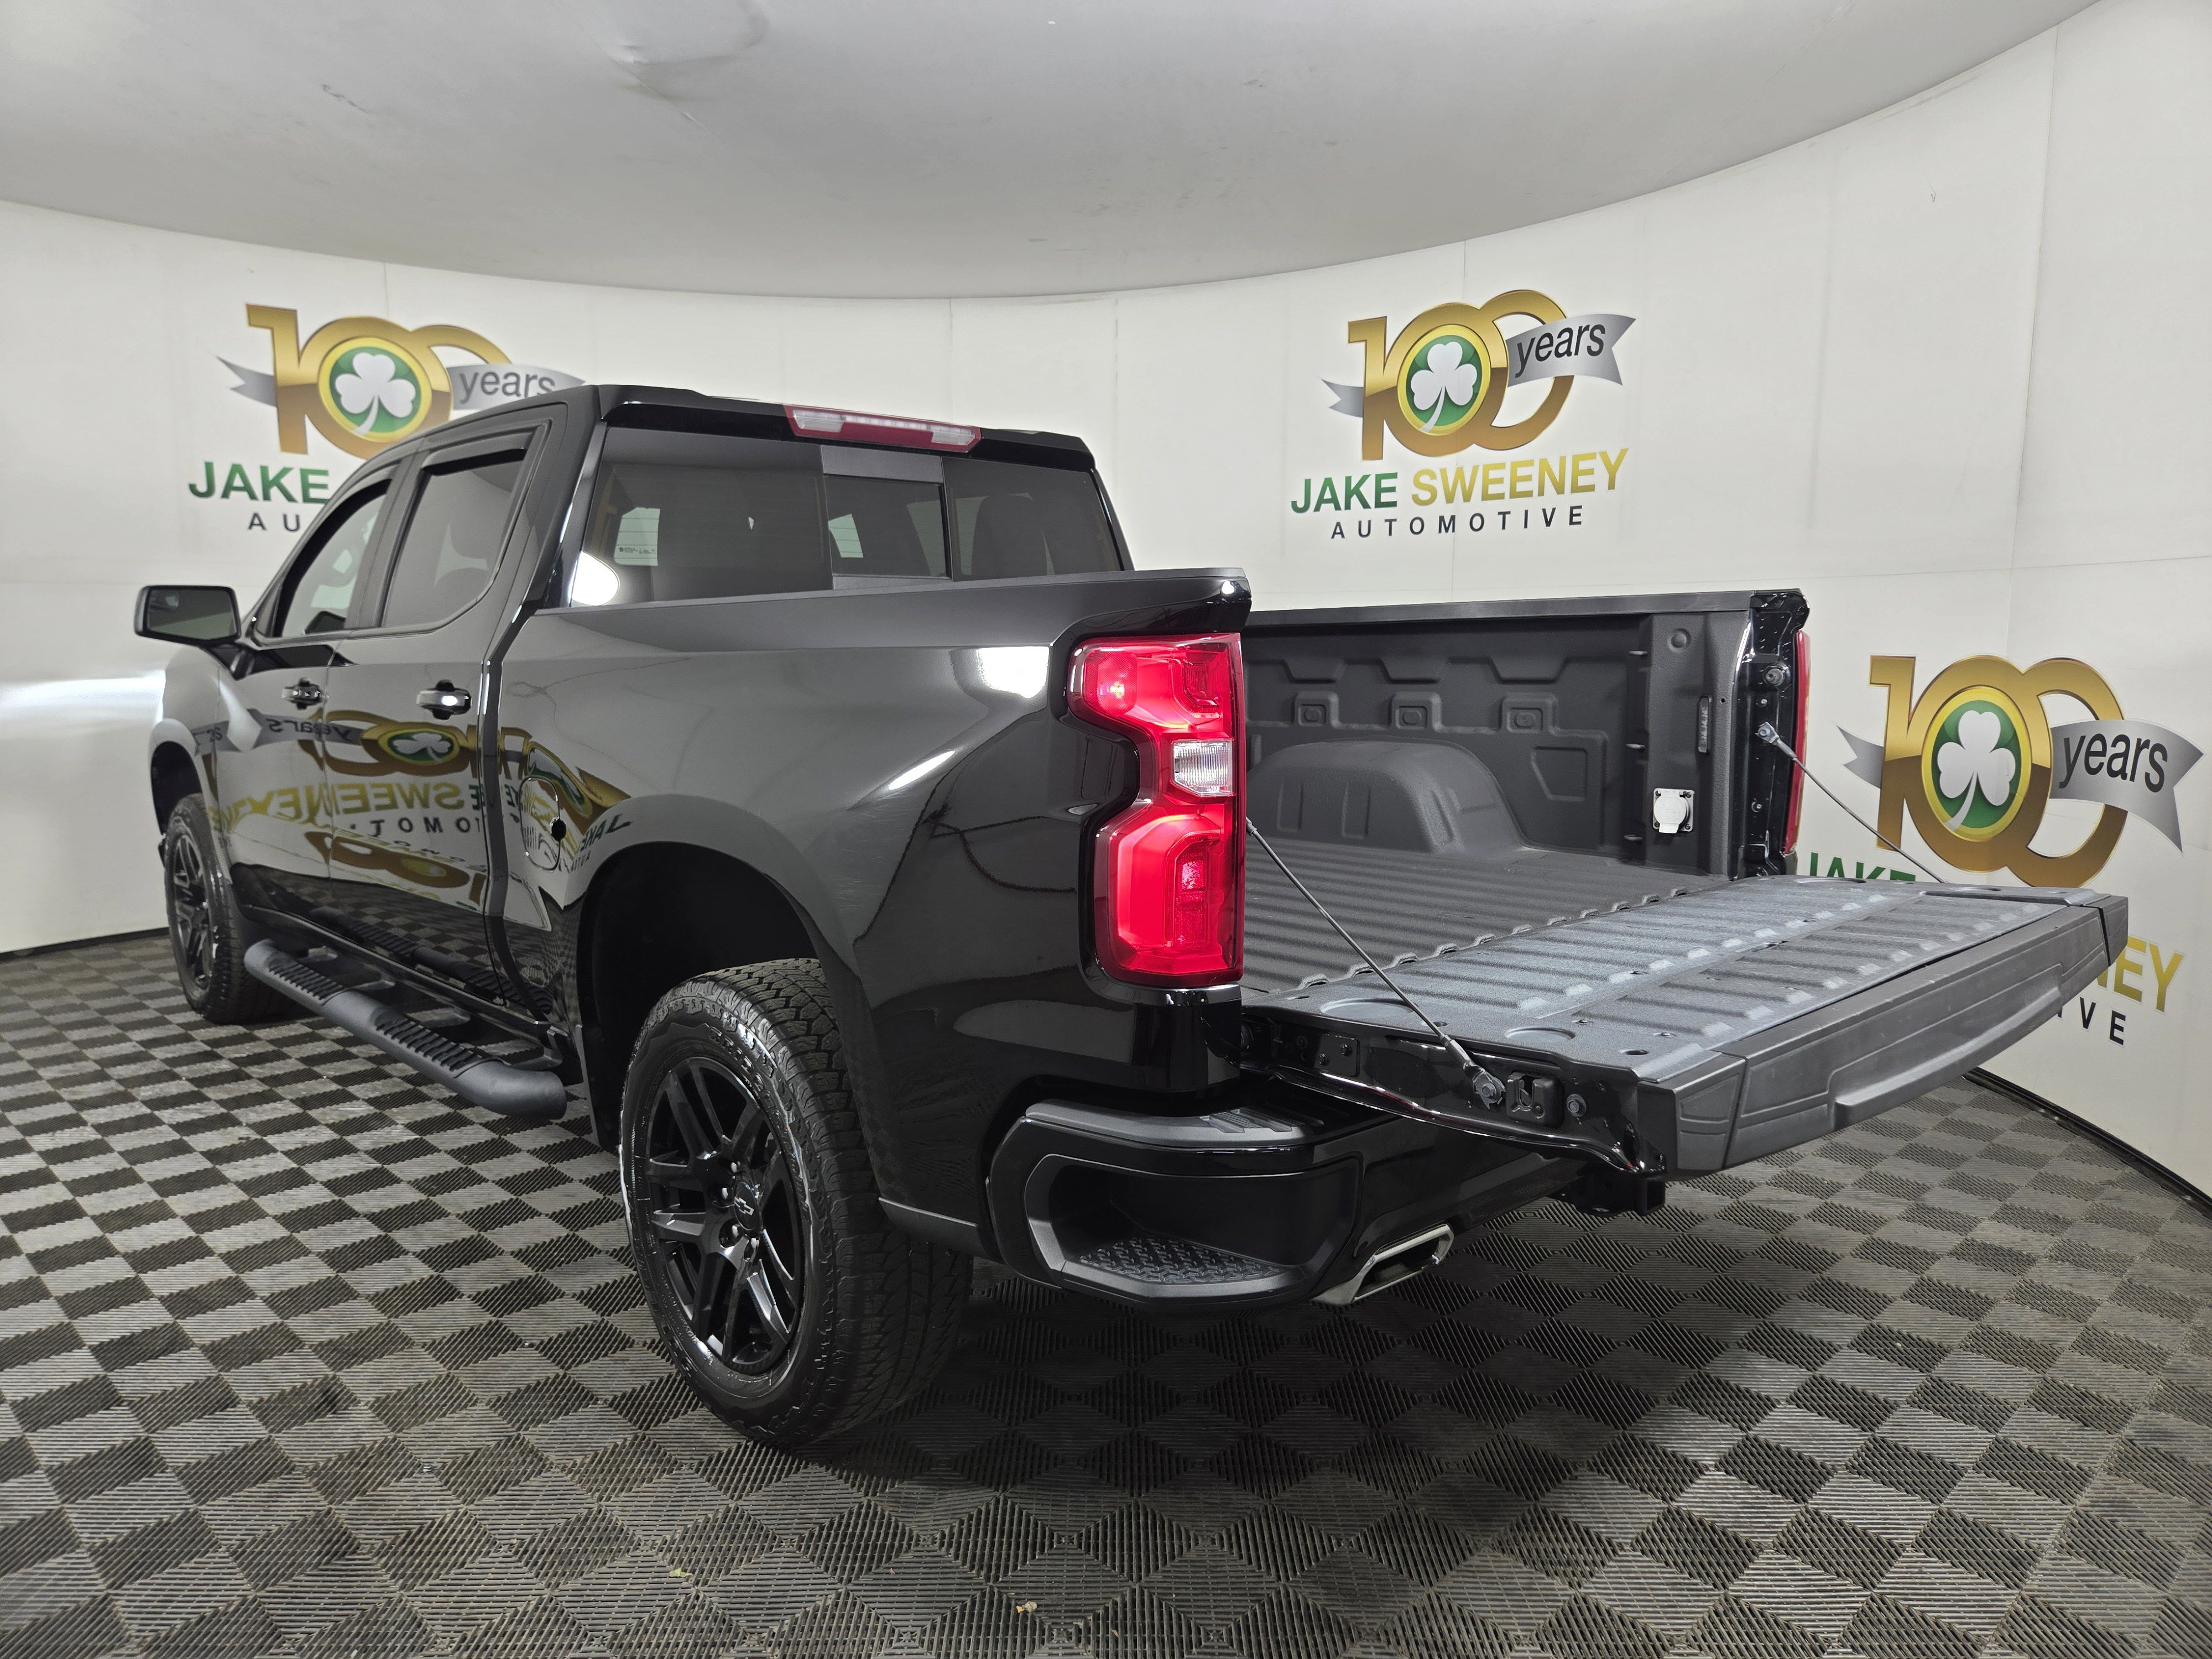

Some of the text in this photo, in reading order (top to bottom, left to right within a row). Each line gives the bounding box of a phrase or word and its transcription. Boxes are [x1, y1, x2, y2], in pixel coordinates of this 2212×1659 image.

[460, 372, 556, 404] years
[1347, 289, 1606, 461] 100 years
[189, 461, 330, 503] JAKE
[1291, 448, 1629, 514] JAKE SWEENEY
[1331, 505, 1583, 540] AUTOMOTIVE
[1869, 654, 2168, 888] 100 years
